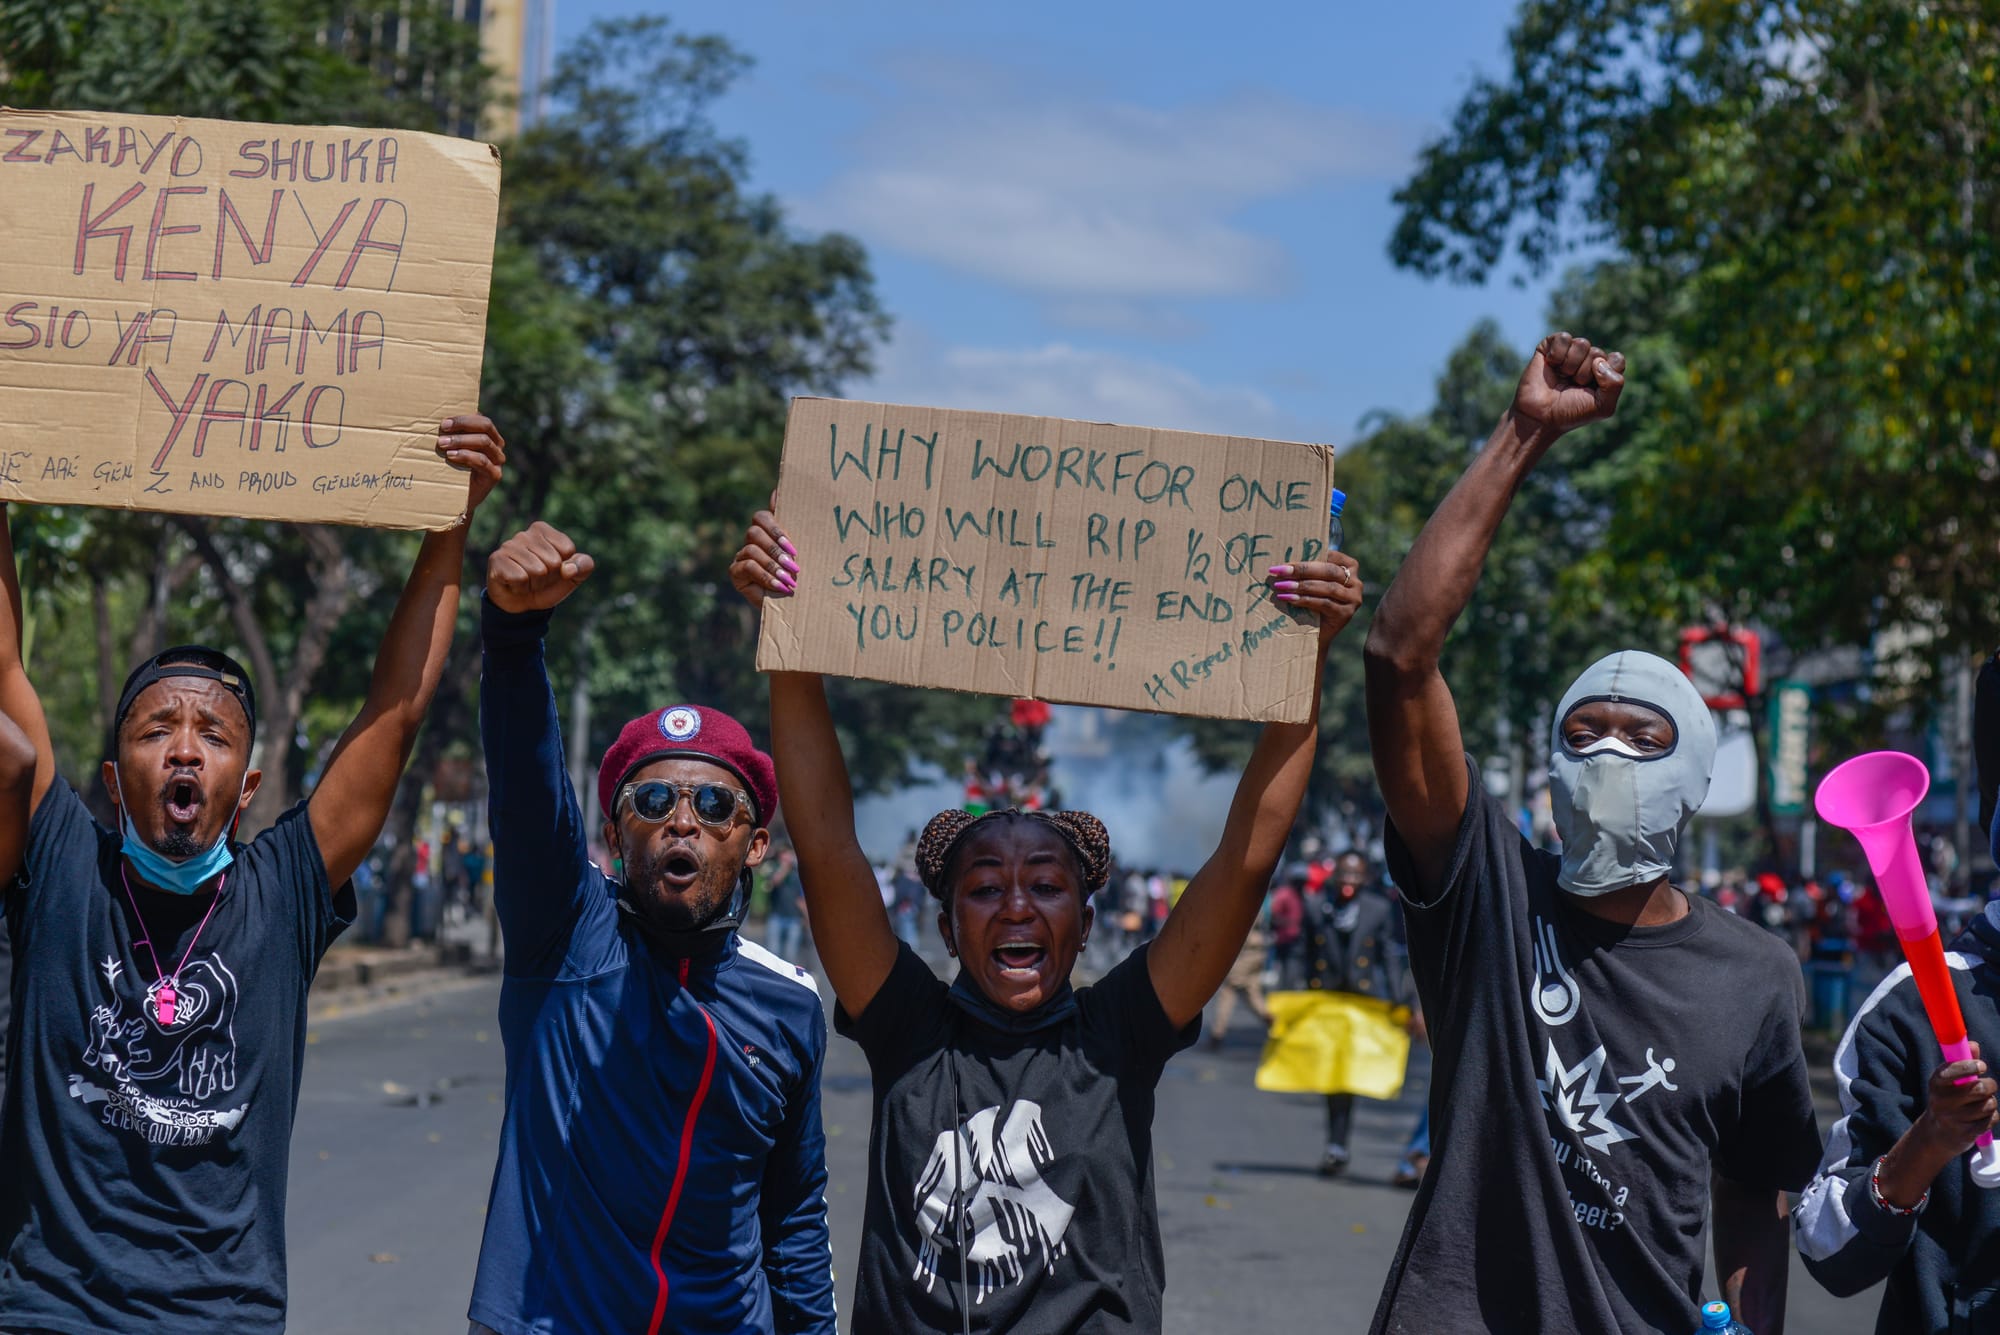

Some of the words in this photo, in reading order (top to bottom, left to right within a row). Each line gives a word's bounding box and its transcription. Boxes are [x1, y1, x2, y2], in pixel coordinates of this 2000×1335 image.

[2, 125, 202, 177] ZAKAYO
[229, 137, 398, 183] SHUKA
[73, 182, 407, 292] KENYA
[0, 302, 91, 349] SIO
[109, 308, 177, 366] YA
[203, 304, 385, 375] MAMA
[145, 367, 345, 470] YAKO
[93, 461, 133, 483] GEN
[144, 471, 172, 493] Z
[190, 472, 225, 491] AND
[238, 471, 297, 494] PROUD
[831, 423, 938, 490] WHY
[1220, 474, 1311, 512] ONE
[833, 501, 925, 544] WHO
[945, 506, 1056, 548] WILL
[1087, 513, 1156, 562] RIP
[1224, 532, 1273, 575] OF
[832, 554, 976, 599] SALARY
[998, 567, 1048, 609] AT
[1070, 572, 1134, 613] THE
[1156, 590, 1233, 623] END
[847, 604, 918, 652] YOU
[942, 609, 1122, 671] POLICE!!
[101, 1105, 148, 1139] SCIENCE
[148, 1123, 180, 1145] QUIZ
[118, 1083, 140, 1096] 2ND
[145, 1094, 200, 1108] ANNUAL
